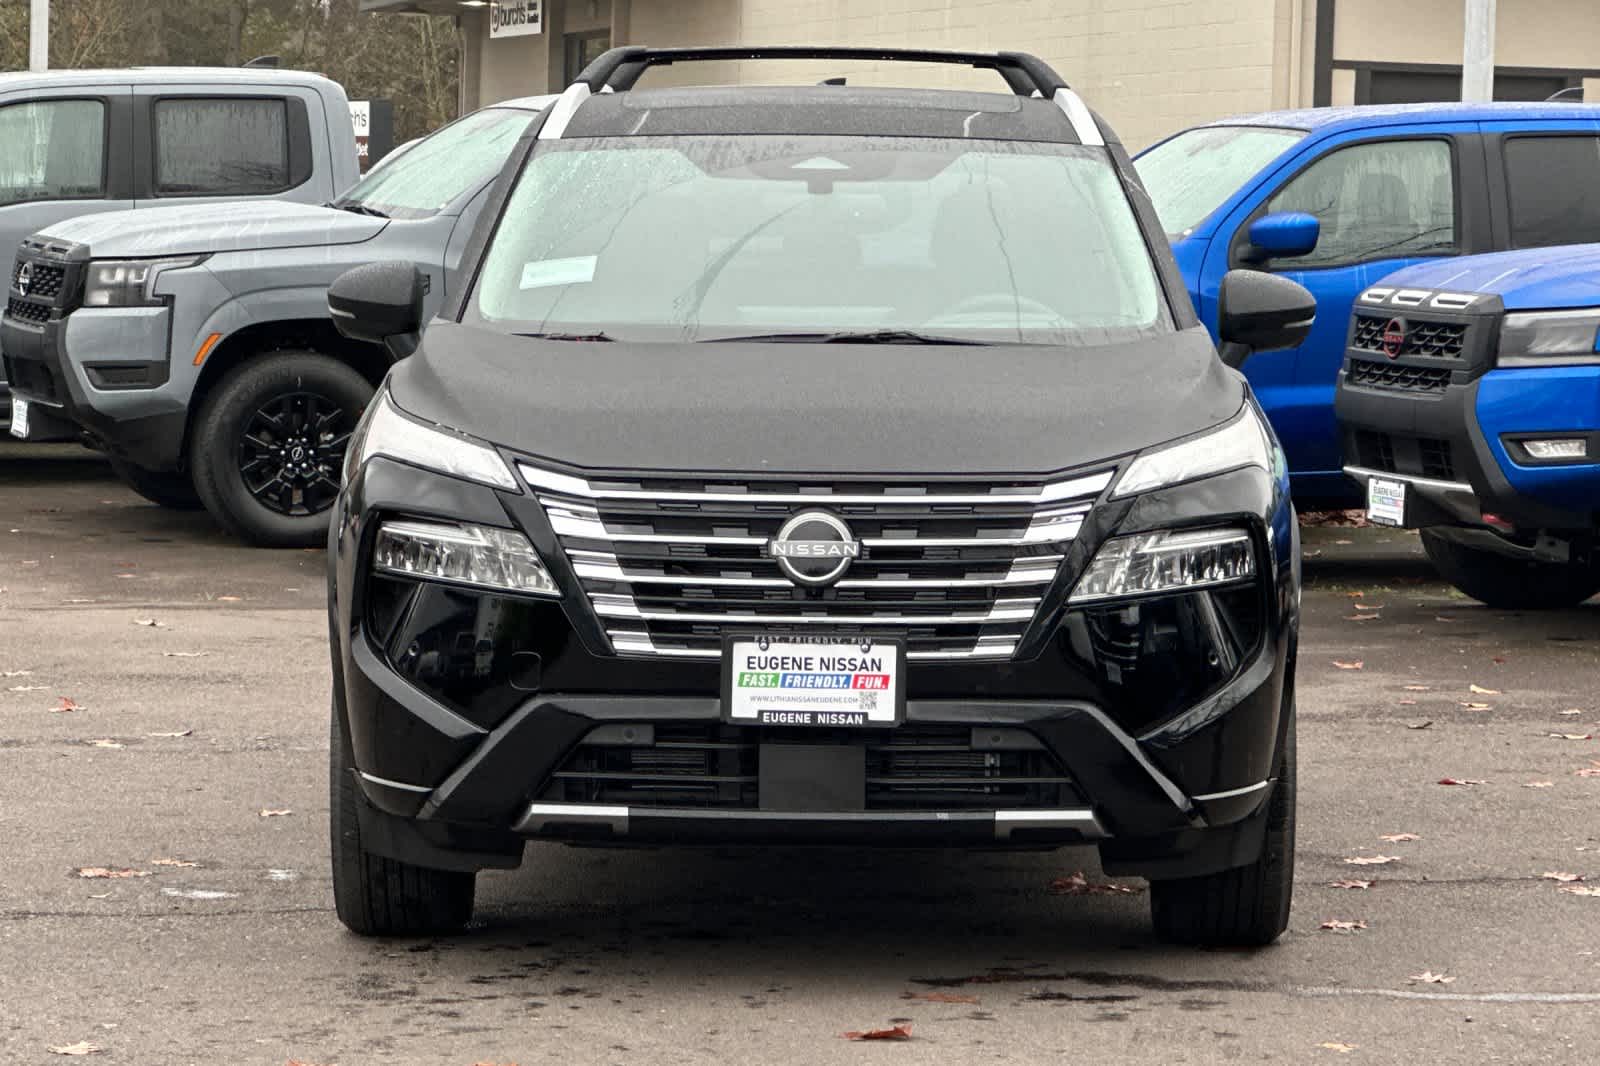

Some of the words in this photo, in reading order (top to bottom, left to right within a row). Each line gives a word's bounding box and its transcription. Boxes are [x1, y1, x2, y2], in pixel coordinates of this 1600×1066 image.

[772, 543, 858, 555] NISSAN
[747, 656, 814, 671] EUGENE
[819, 657, 882, 672] NISSAN
[742, 674, 776, 687] FAST.
[784, 675, 848, 688] FRIENDLY.
[856, 676, 887, 689] FUN.
[762, 712, 811, 723] EUGENE
[817, 713, 863, 725] NISSAN
